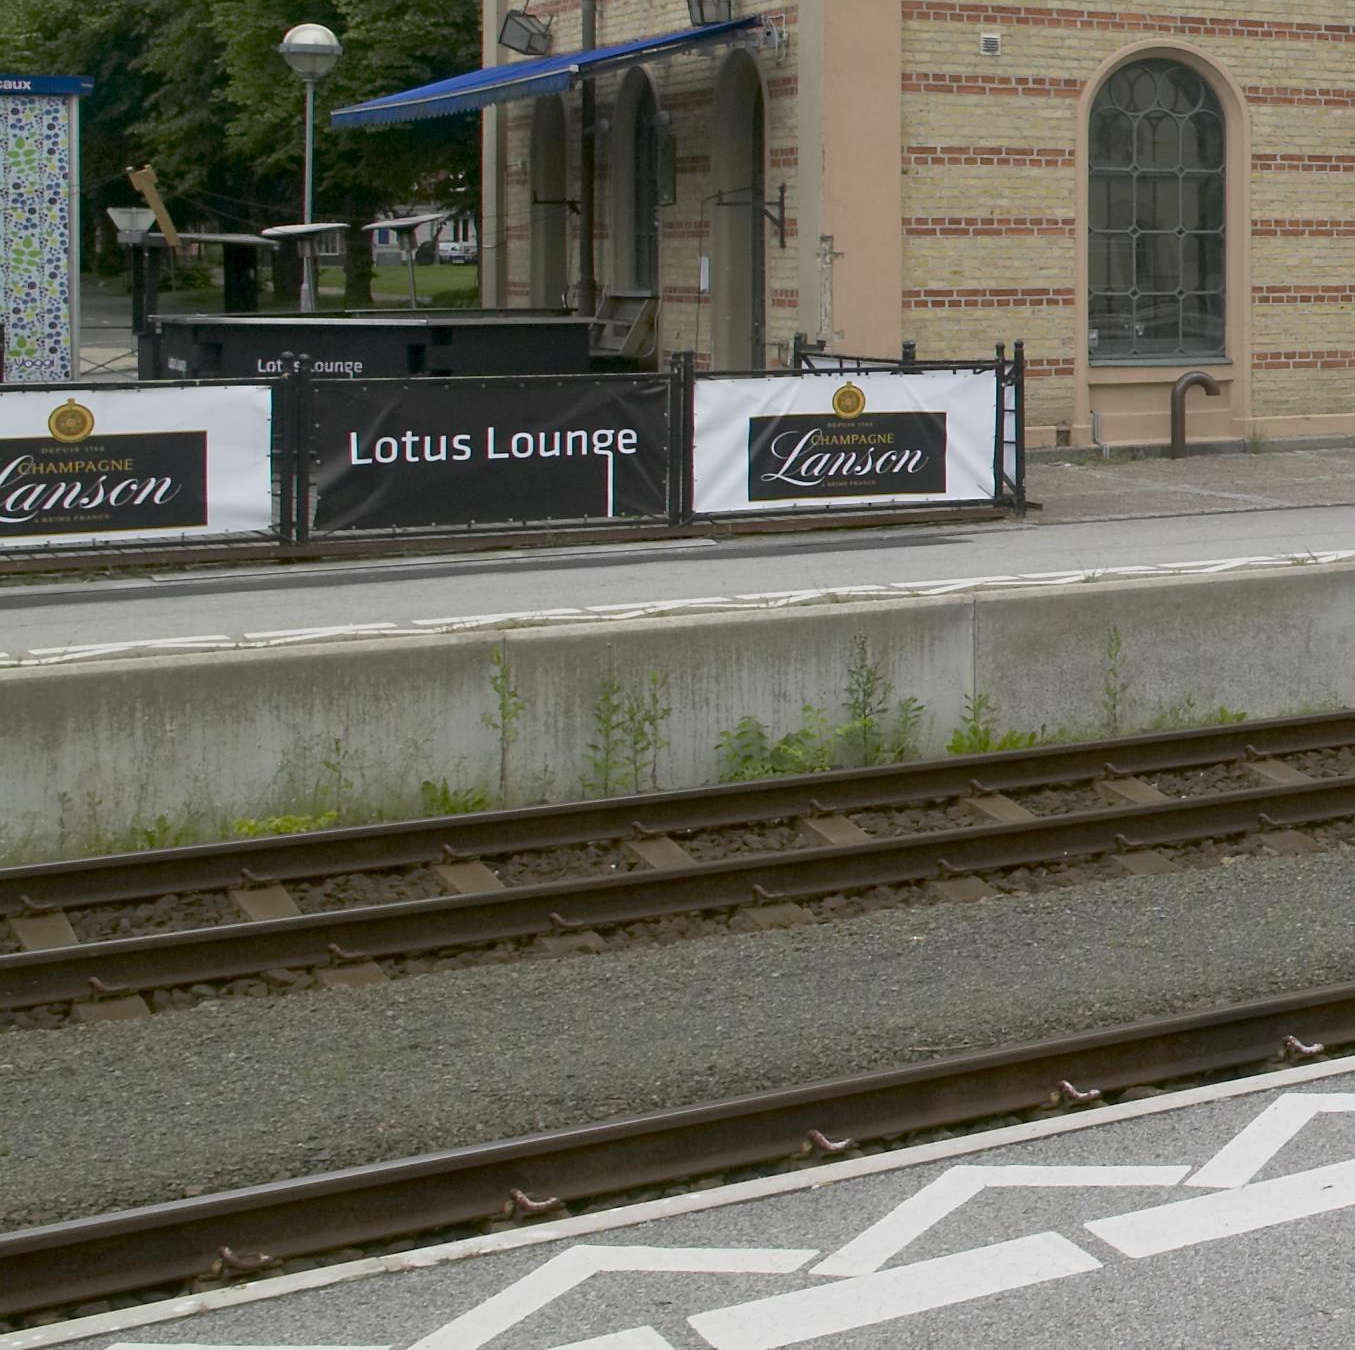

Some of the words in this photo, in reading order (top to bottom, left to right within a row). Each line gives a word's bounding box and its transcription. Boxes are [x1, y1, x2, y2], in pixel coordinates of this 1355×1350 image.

[257, 359, 301, 373] Lots
[310, 361, 363, 379] ounge
[350, 430, 472, 465] Lotus
[810, 433, 894, 447] CHAMPAGNE
[18, 458, 135, 475] CHAMPAGNE
[760, 428, 929, 487] Lanson
